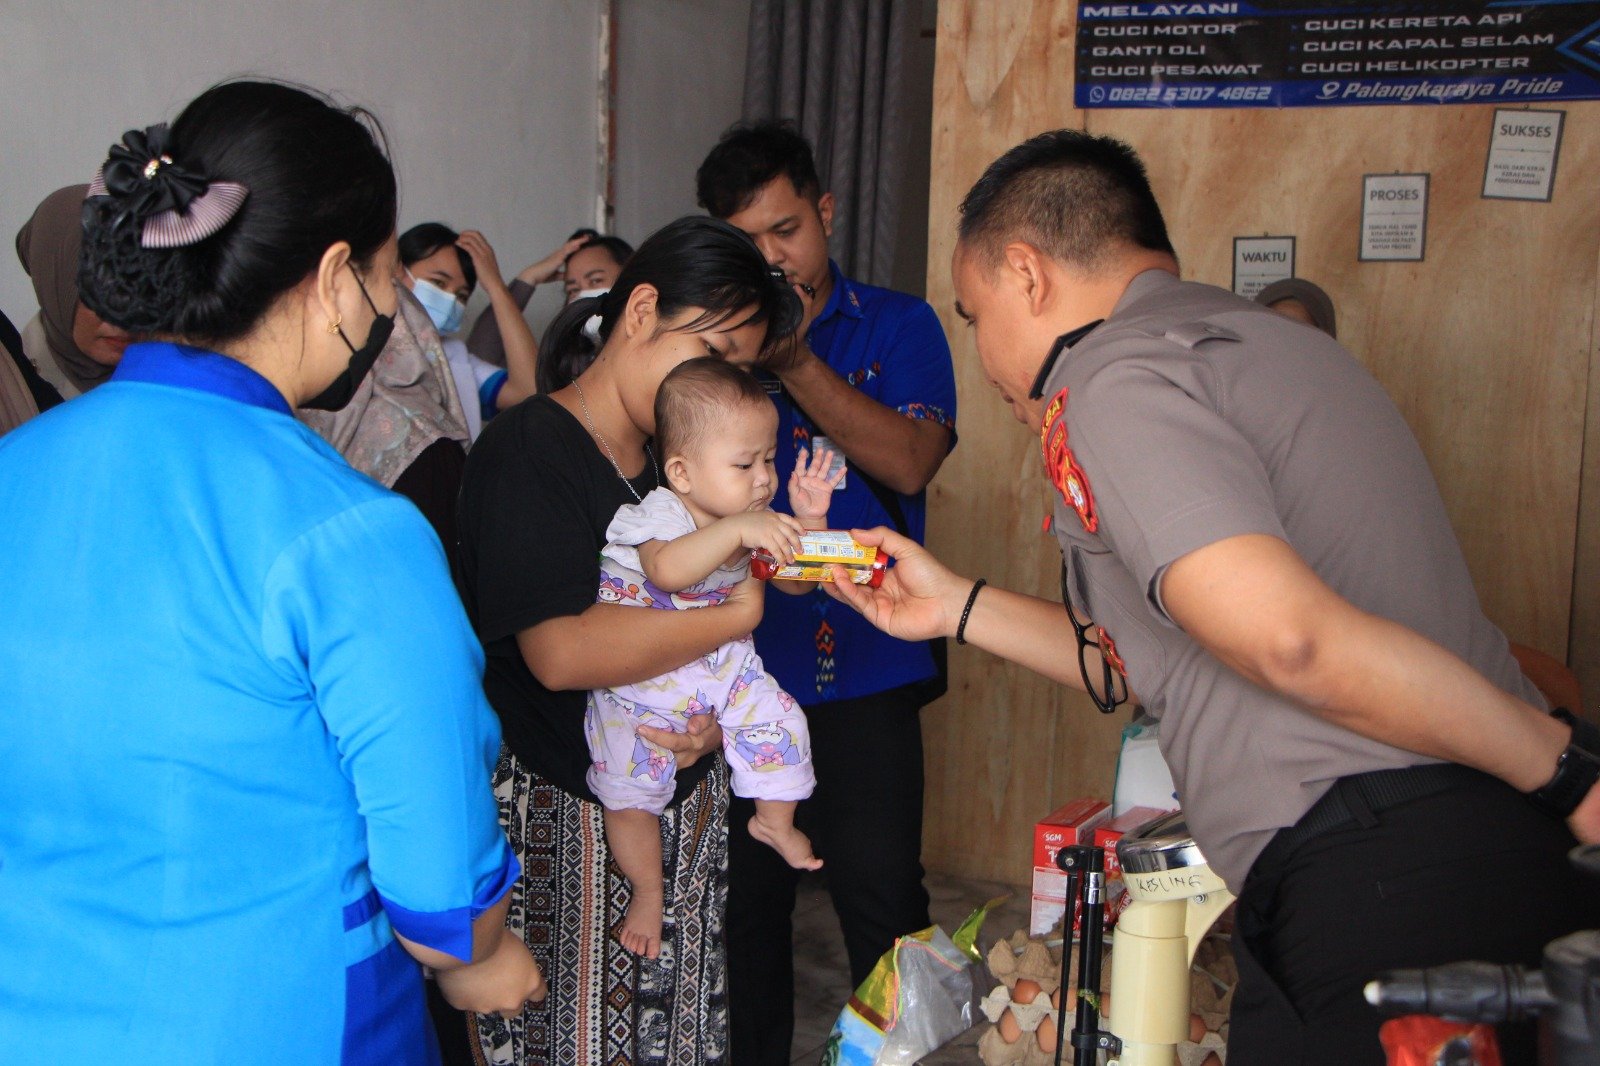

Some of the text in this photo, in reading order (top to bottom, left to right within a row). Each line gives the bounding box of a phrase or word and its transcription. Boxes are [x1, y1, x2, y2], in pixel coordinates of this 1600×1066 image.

[1083, 3, 1238, 18] MELAYANI
[1305, 13, 1523, 31] CUCI KERETA API
[1093, 24, 1237, 37] CUCI MOTOR
[1303, 33, 1555, 53] CUCI KAPAL SELAM
[1092, 45, 1206, 57] GANTI OLI
[1090, 64, 1262, 77] CUCI PESAWAT
[1301, 57, 1531, 74] CUCI HELIKOPTER
[1108, 87, 1160, 101] 0822
[1163, 86, 1216, 101] 5307
[1341, 78, 1564, 102] Palangkaraya Pride
[1500, 124, 1552, 138] SUKSES
[1370, 189, 1419, 201] PROSES
[1241, 252, 1287, 262] WAKTU
[1044, 833, 1062, 842] SGM
